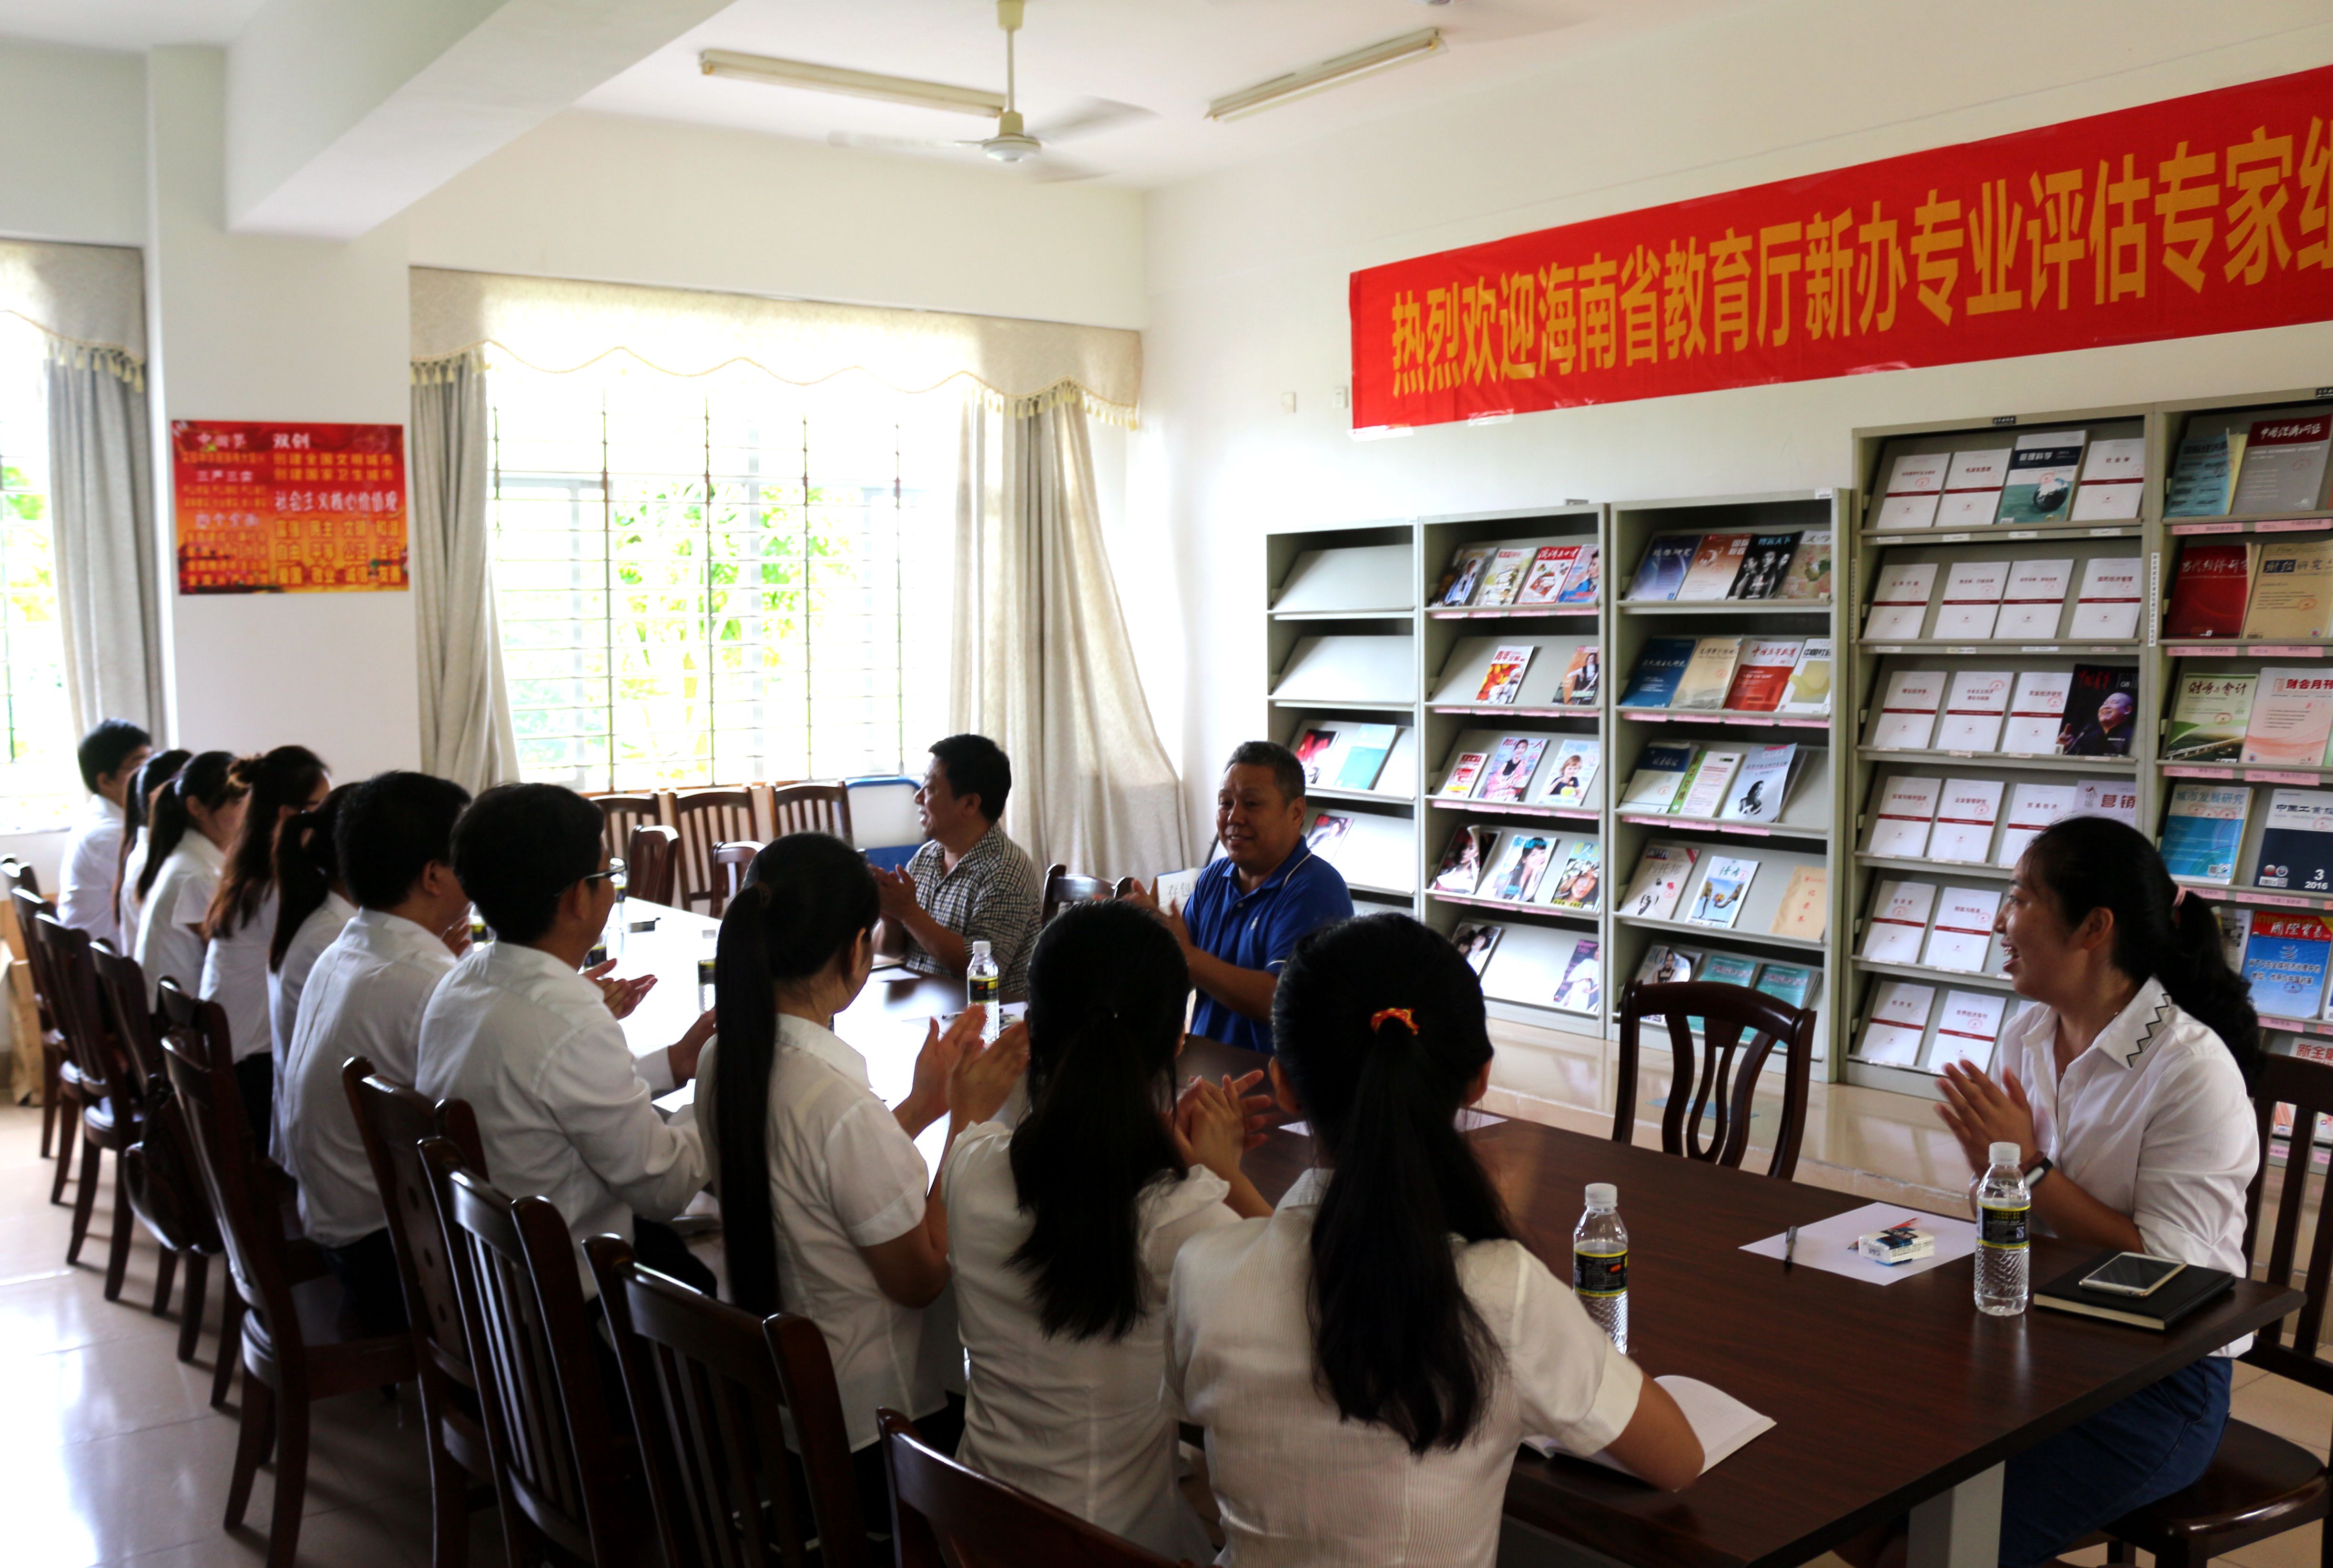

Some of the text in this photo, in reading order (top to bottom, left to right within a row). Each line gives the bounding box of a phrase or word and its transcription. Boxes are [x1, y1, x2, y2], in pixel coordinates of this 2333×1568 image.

[274, 433, 309, 448] 双创
[275, 491, 397, 512] 社会主义核心价值观
[2101, 794, 2137, 809] 营销
[2314, 869, 2325, 881] 3
[2304, 881, 2326, 890] 2016
